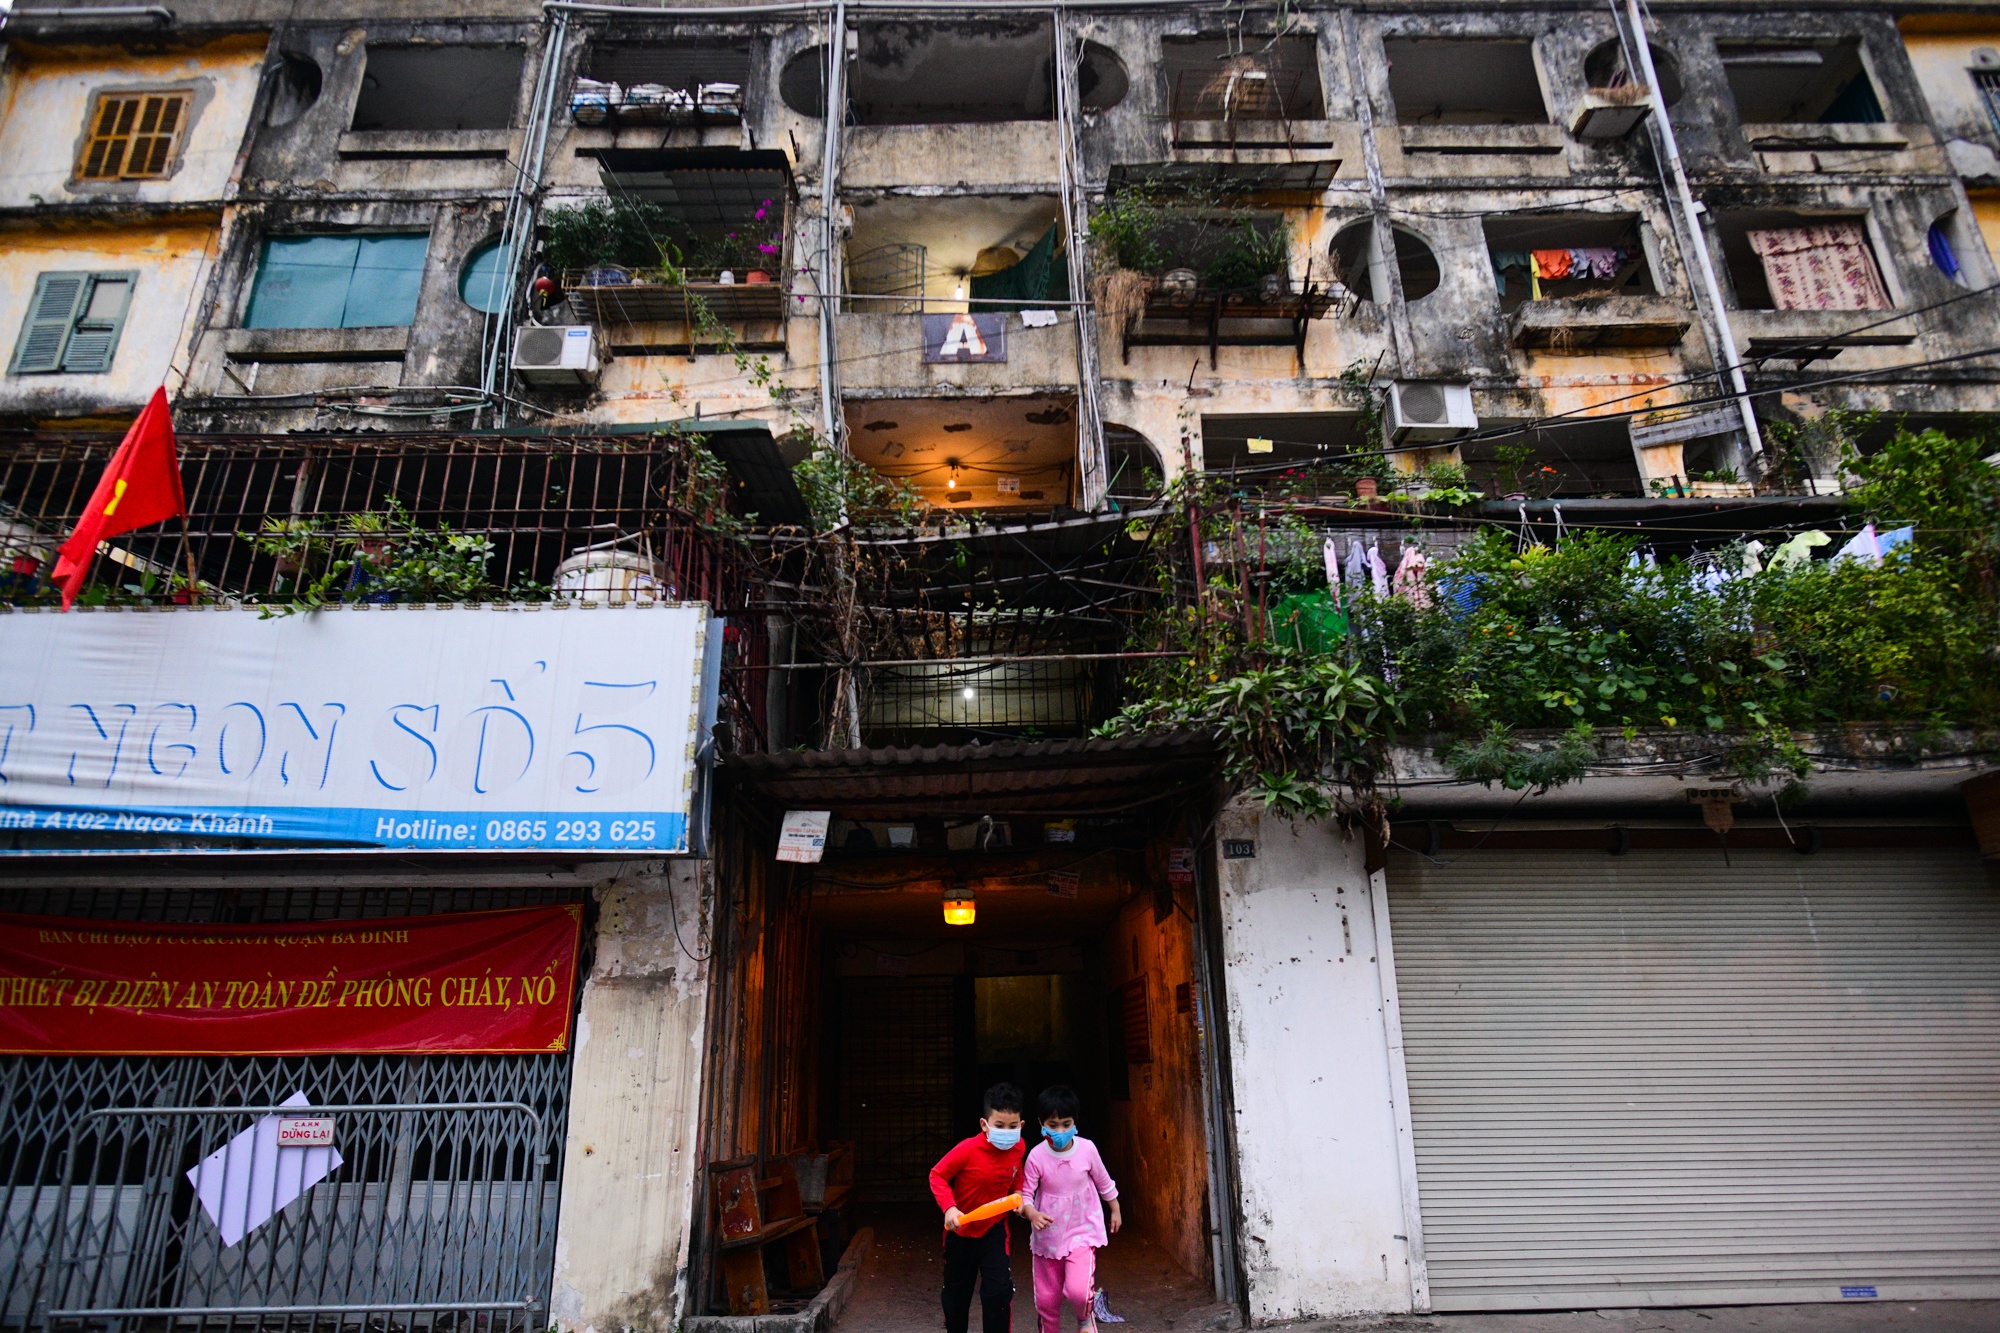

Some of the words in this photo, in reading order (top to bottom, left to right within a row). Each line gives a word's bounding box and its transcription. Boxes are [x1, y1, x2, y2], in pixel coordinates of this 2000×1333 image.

[939, 314, 988, 355] A
[62, 701, 347, 790] NGON
[558, 680, 657, 795] 5
[42, 811, 110, 830] A102
[190, 813, 273, 834] Khánh
[375, 817, 476, 840] Hotline:
[486, 819, 546, 841] 0865
[555, 819, 601, 841] 293
[609, 820, 656, 841] 625
[1229, 843, 1251, 855] 103
[38, 930, 74, 944] BAN
[71, 976, 105, 1015] BỊ
[103, 971, 183, 1016] ĐIỆN
[176, 980, 220, 1009] AN
[221, 971, 296, 1009] TOÀN
[294, 966, 340, 1008] ĐỀ
[336, 971, 433, 1008] PHÒNG
[440, 967, 512, 1012] CHÁY,
[517, 959, 558, 1006] NỔ
